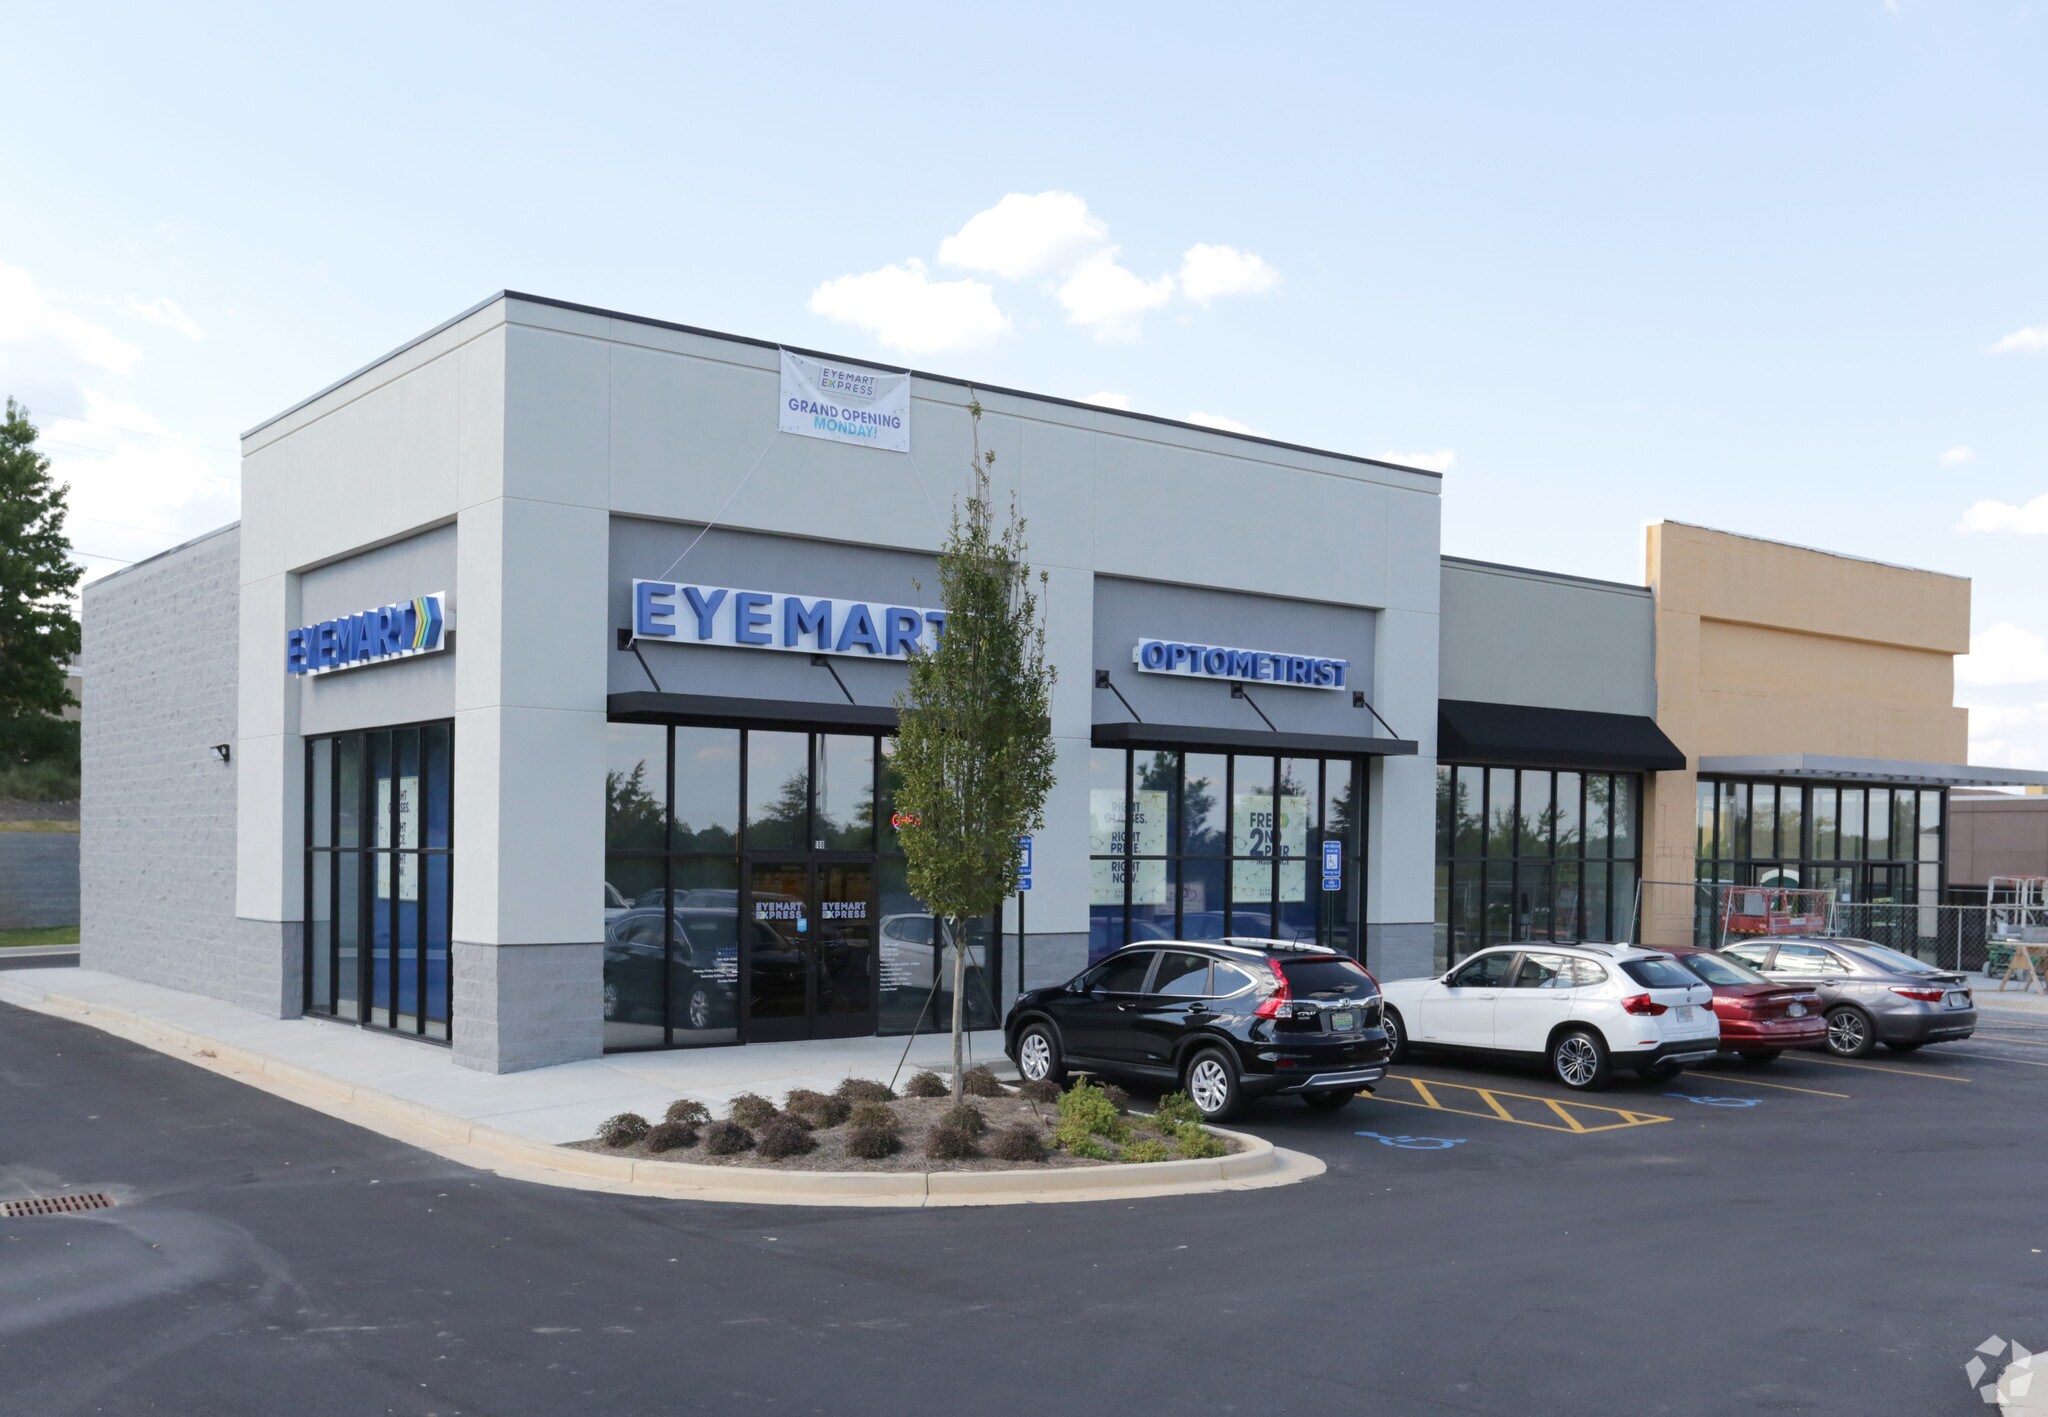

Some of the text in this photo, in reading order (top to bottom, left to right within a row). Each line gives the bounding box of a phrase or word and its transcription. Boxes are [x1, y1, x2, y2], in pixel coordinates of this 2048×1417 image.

[823, 368, 876, 386] EYEMART
[821, 378, 874, 396] EXPRESS
[788, 398, 901, 429] GRAND OPENING
[814, 416, 878, 439] MONDAY!
[287, 600, 417, 675] EYEMART
[1141, 641, 1351, 687] OPTOMETRIST
[1104, 812, 1148, 824] GLAES.
[1110, 843, 1141, 854] PRIE.
[1264, 845, 1290, 857] PIR
[755, 902, 803, 911] EYEMART
[822, 902, 867, 911] EYEMART
[755, 910, 802, 920] EXPRESS
[822, 910, 867, 919] EXPRESS
